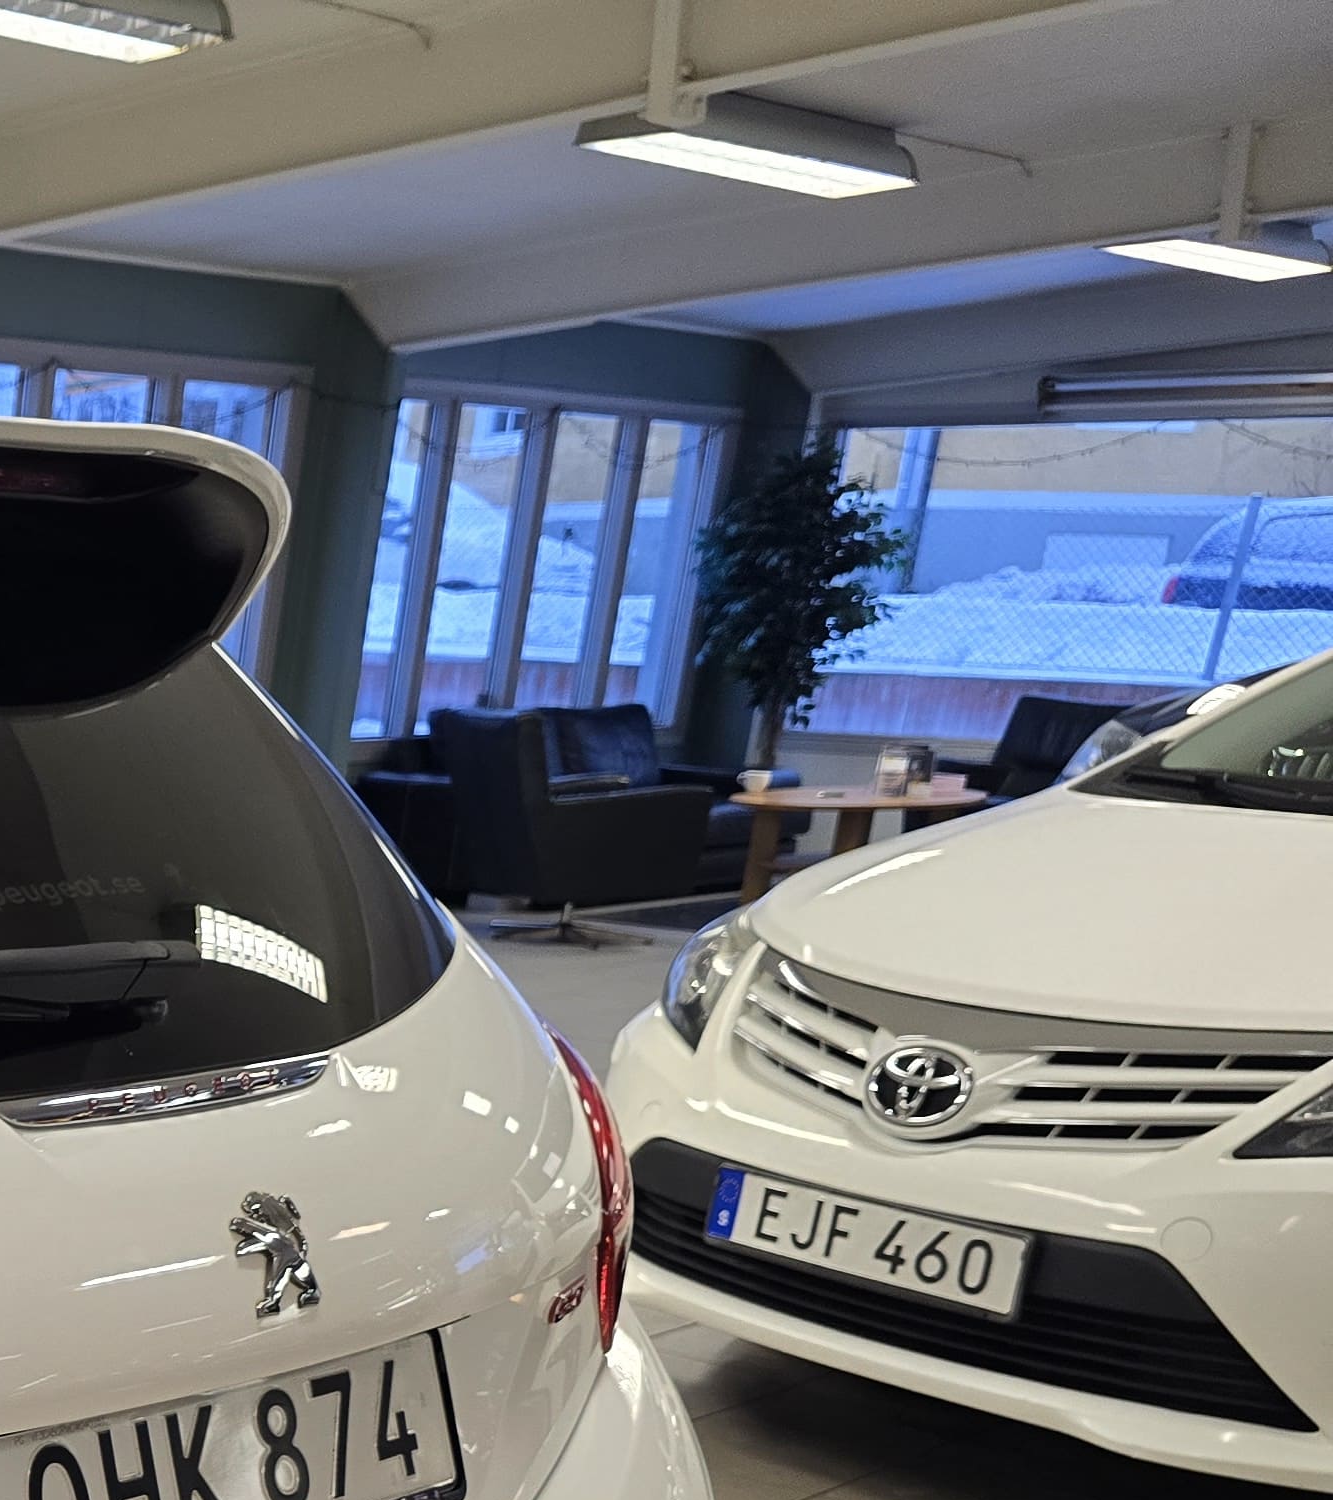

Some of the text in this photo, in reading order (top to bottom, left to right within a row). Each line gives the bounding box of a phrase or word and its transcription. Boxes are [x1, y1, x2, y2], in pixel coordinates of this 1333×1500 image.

[88, 1067, 279, 1112] PEUGEOT
[754, 1186, 993, 1295] EJF 460
